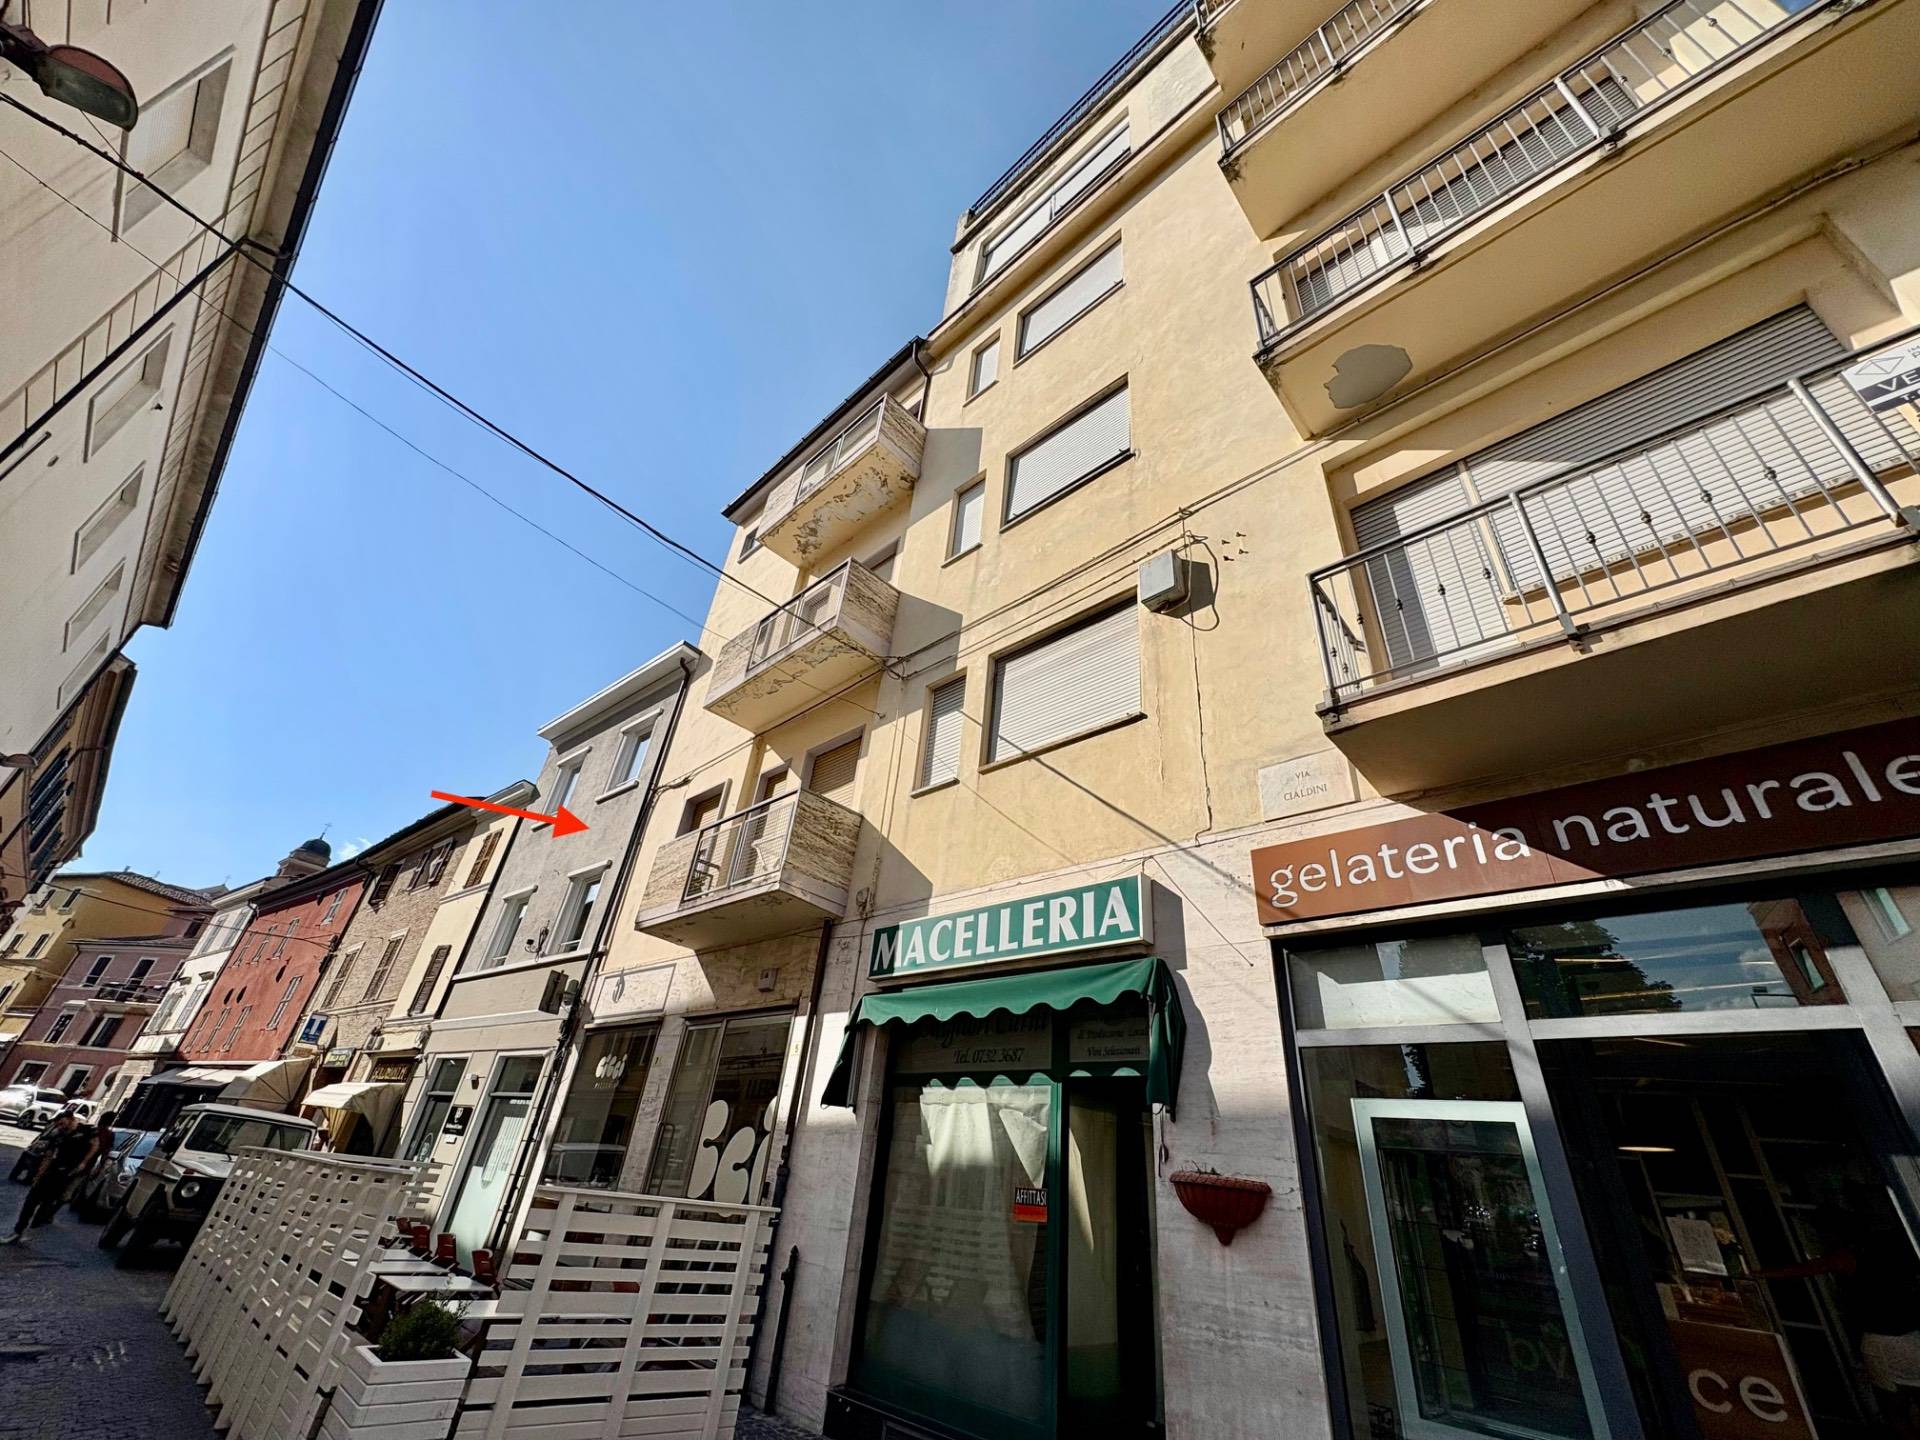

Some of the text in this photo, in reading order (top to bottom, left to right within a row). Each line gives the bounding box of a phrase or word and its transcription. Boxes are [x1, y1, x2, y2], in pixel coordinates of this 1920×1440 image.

[1294, 770, 1311, 779] VIA
[1283, 783, 1328, 801] CIALDINI
[1270, 751, 1920, 908] gelateria naturale
[873, 886, 1134, 972] MACELLERIA
[1015, 1189, 1047, 1206] AFFITTASI
